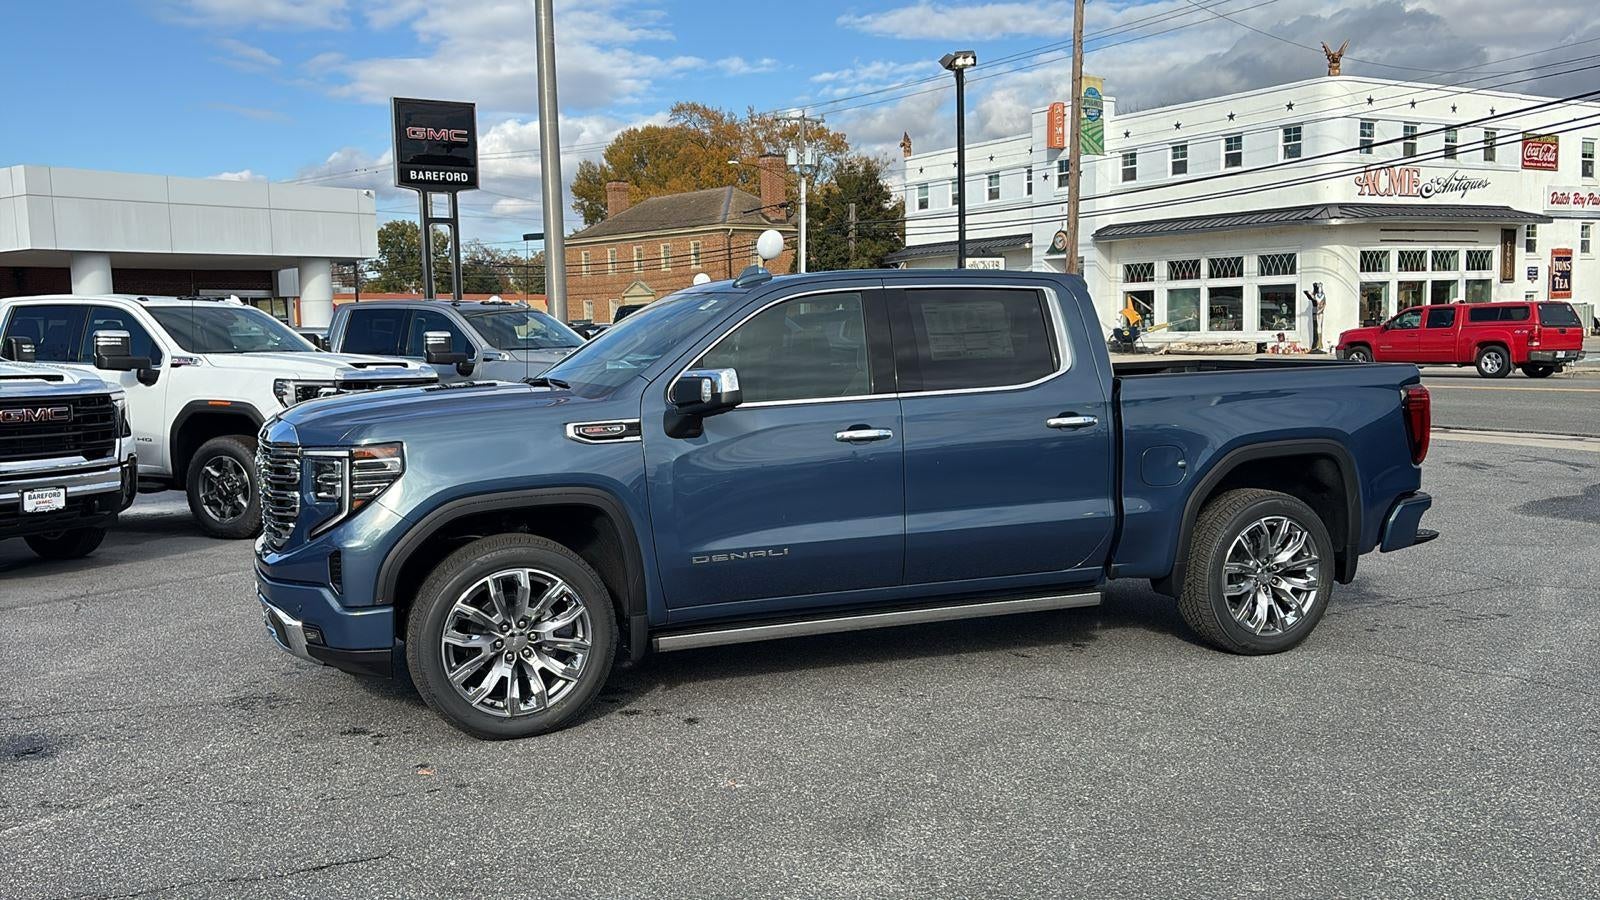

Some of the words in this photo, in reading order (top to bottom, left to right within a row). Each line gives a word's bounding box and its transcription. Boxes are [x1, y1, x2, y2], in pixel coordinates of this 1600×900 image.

[1055, 104, 1063, 145] ACME
[406, 126, 468, 142] GMC
[410, 170, 468, 182] BAREFORD
[1355, 166, 1420, 197] ACME
[1550, 191, 1570, 205] Dutch
[1573, 192, 1587, 208] Boy
[1554, 277, 1568, 289] TEA
[0, 407, 69, 423] GMC
[27, 491, 61, 501] BAREFORD
[691, 548, 789, 564] DENALI
